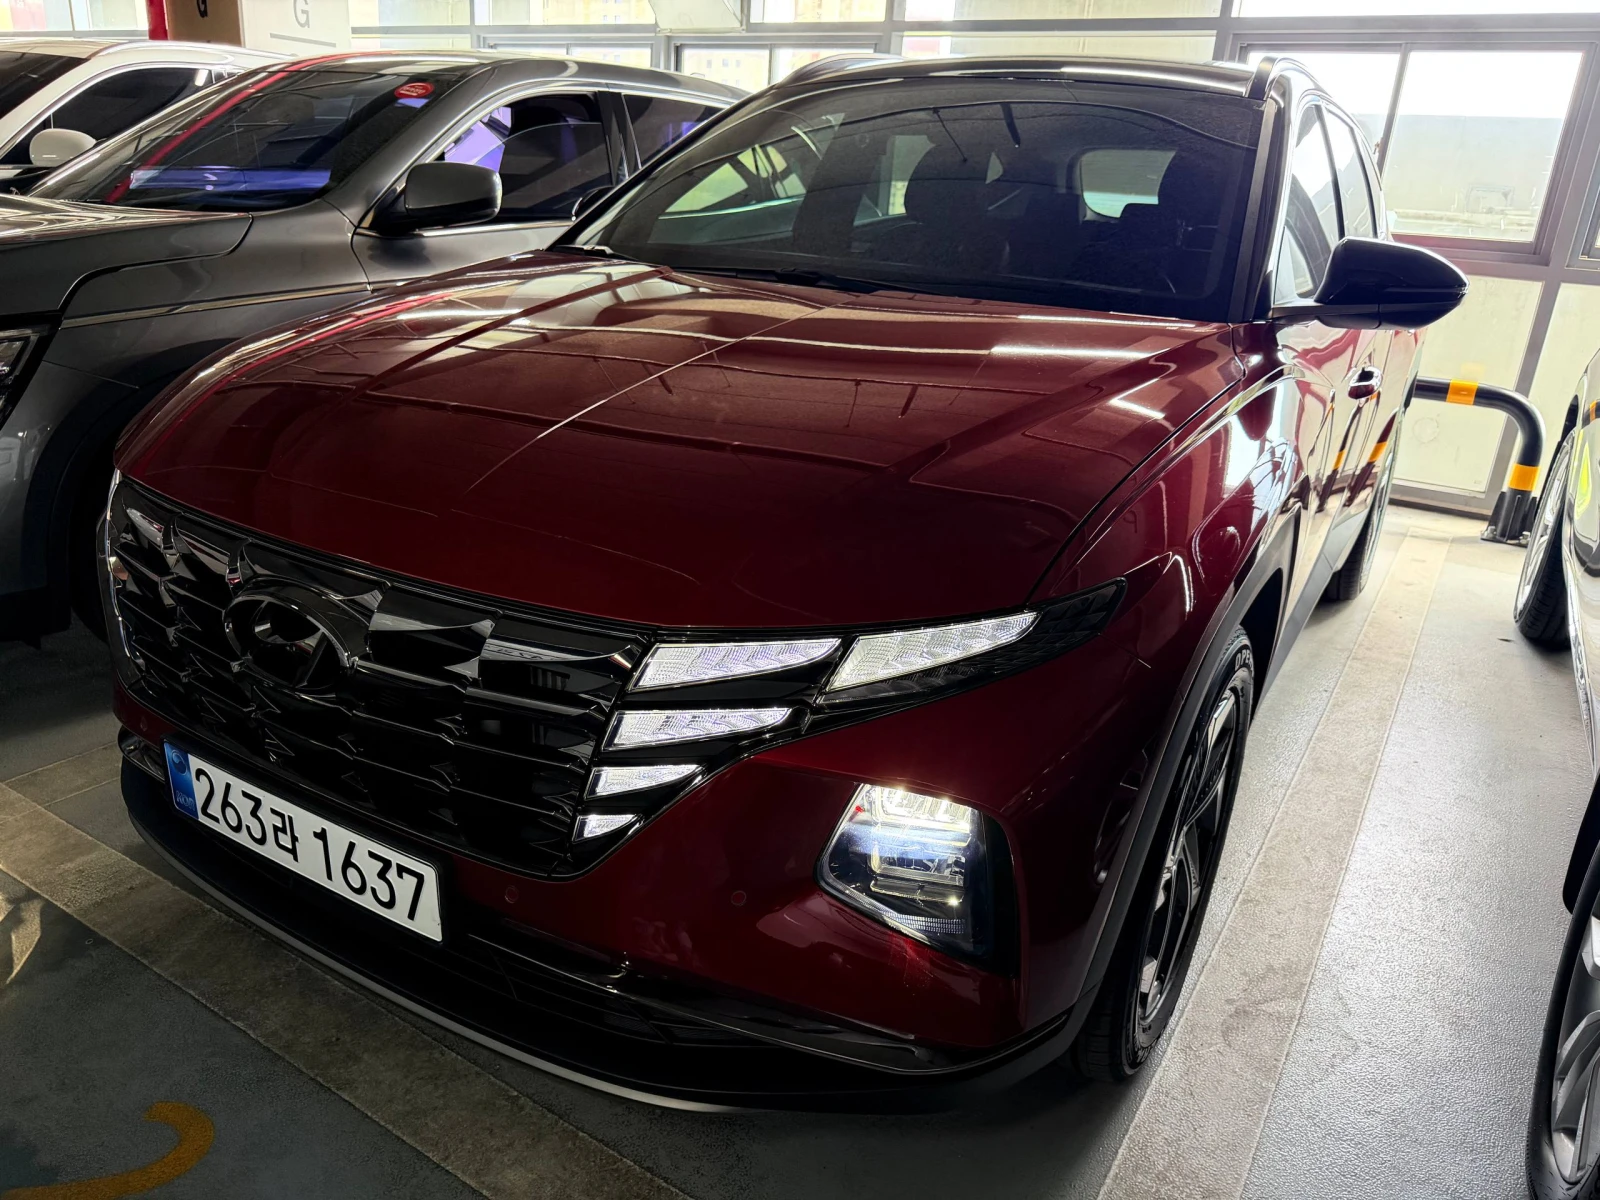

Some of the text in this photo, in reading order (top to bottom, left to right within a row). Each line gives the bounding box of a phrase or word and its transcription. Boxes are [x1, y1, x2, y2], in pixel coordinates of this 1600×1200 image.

[293, 0, 310, 29] G
[176, 790, 196, 812] KOR
[195, 767, 425, 922] 263라 1637
